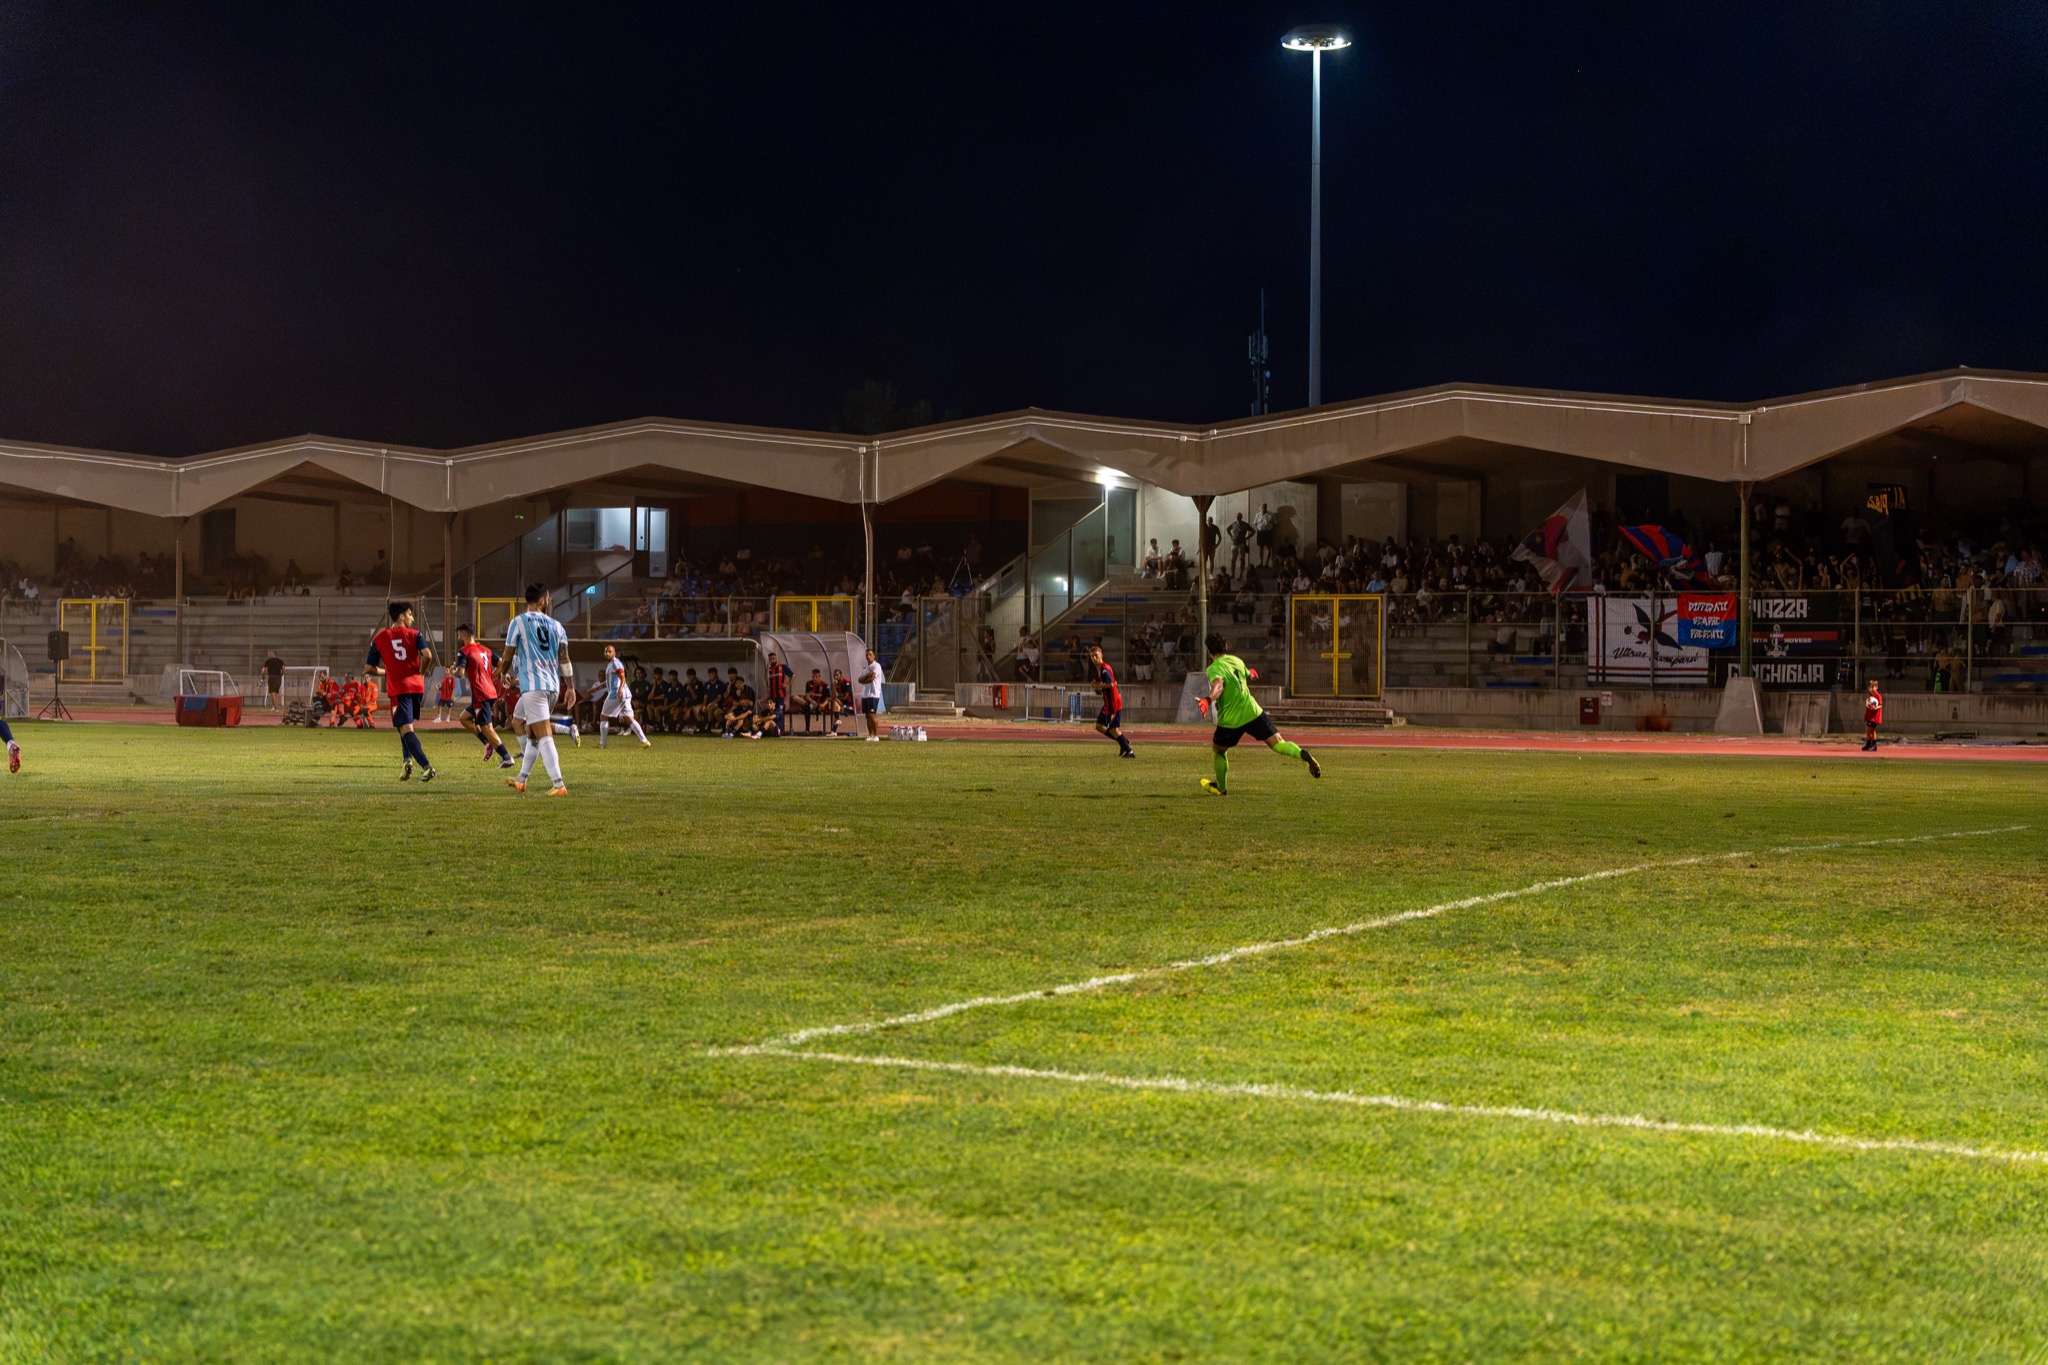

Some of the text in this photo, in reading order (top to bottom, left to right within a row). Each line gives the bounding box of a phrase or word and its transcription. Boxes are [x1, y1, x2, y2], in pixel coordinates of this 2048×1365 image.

[536, 625, 550, 651] 9
[1690, 628, 1724, 639] PRESENTI
[391, 639, 407, 661] 5
[1728, 663, 1824, 683] CNCHIGLIA
